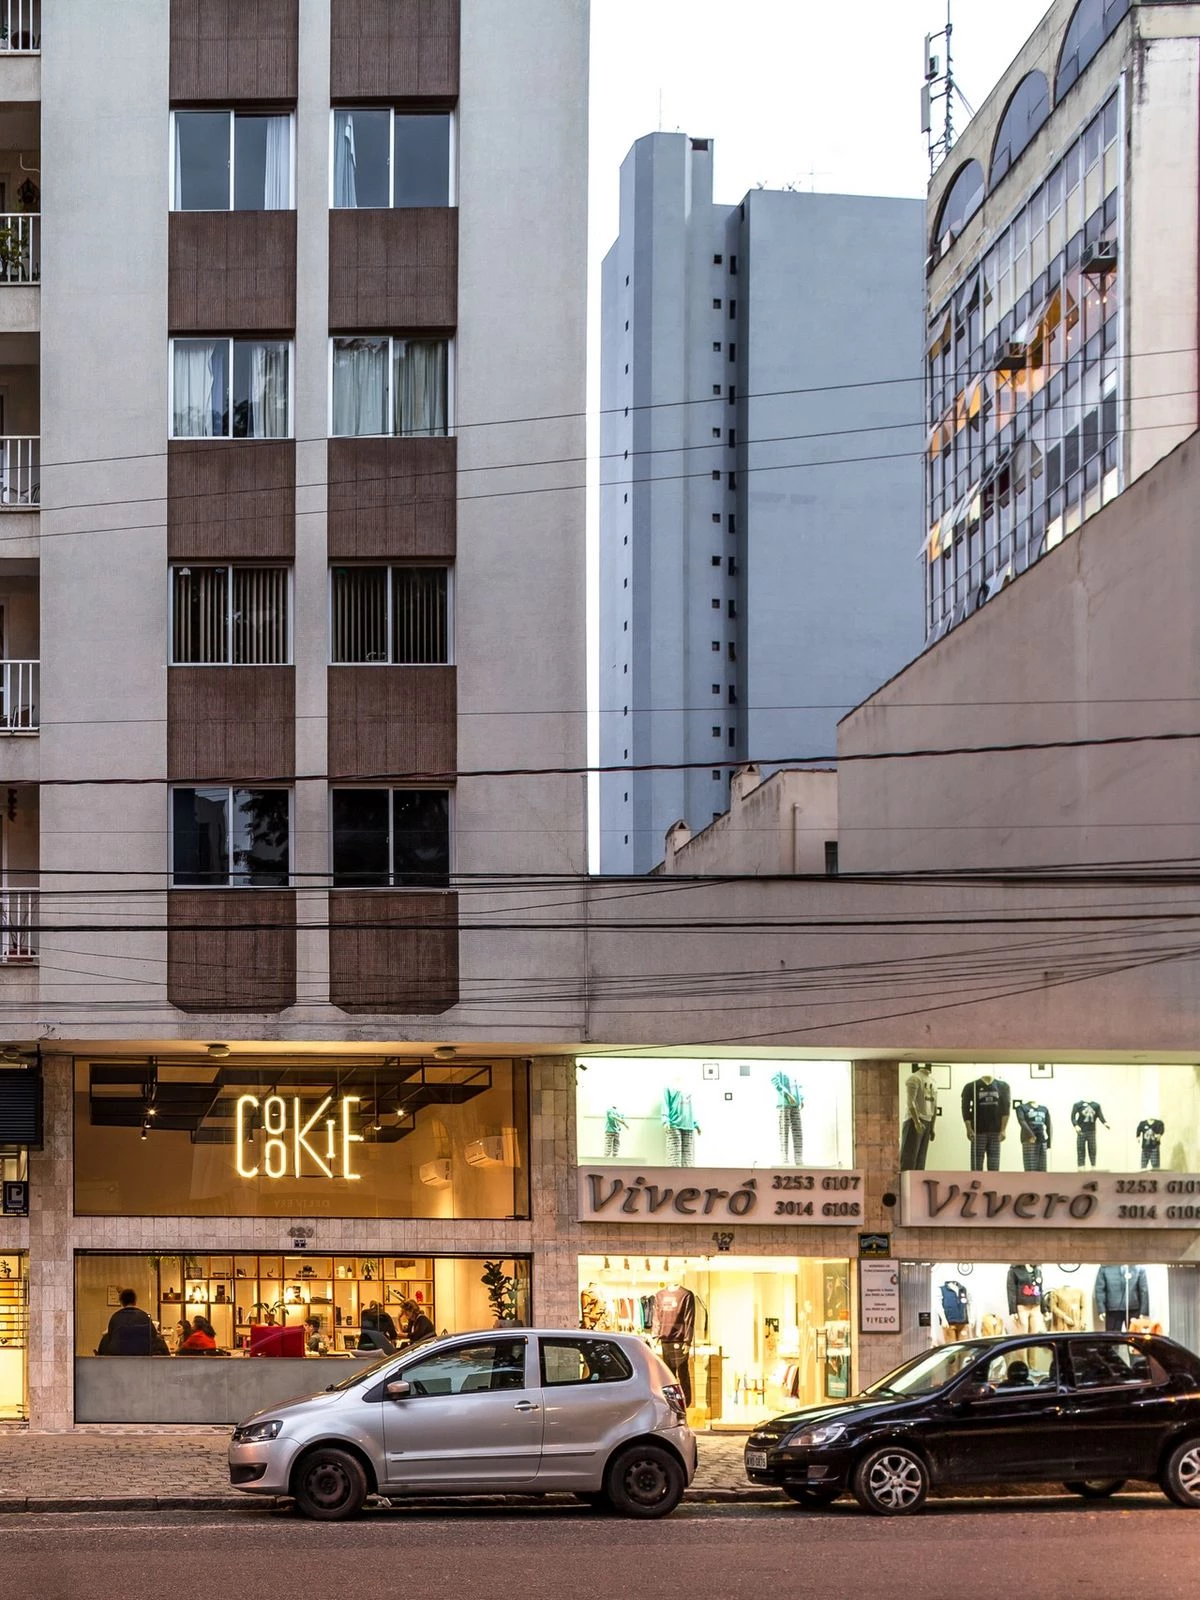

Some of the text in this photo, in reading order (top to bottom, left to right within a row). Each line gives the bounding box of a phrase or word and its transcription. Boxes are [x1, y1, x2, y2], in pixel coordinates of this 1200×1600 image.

[236, 1095, 365, 1179] COOKIE
[772, 1175, 861, 1191] 3253 6107
[1116, 1180, 1158, 1194] 3253
[774, 1201, 861, 1217] 3014 6108
[1117, 1205, 1158, 1220] 3014
[712, 1232, 734, 1245] 429
